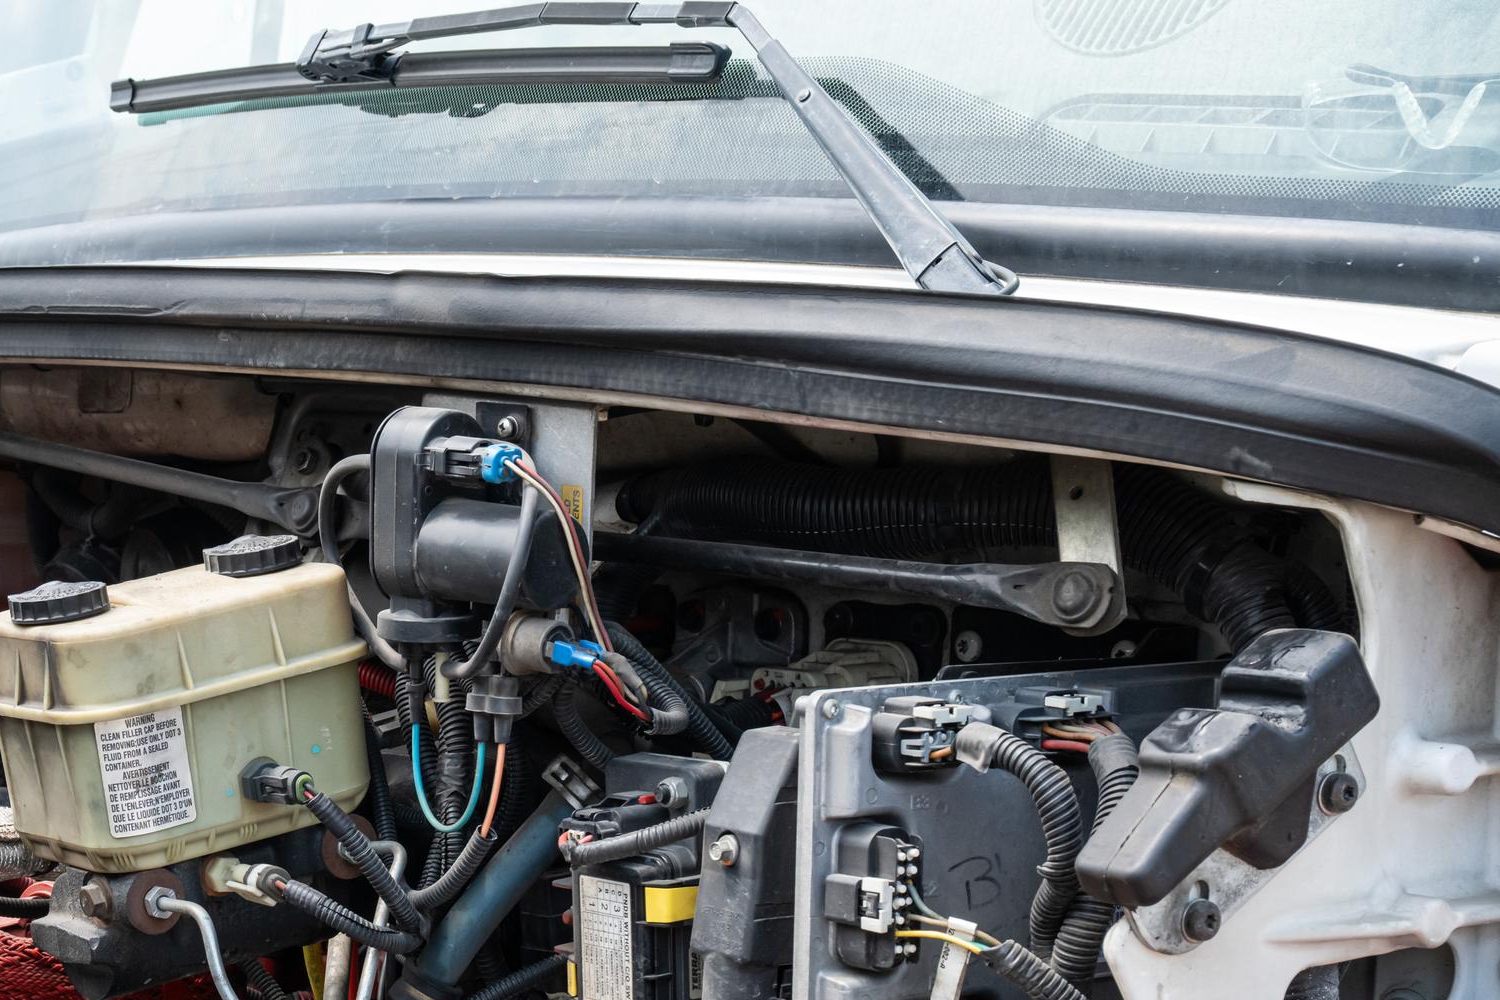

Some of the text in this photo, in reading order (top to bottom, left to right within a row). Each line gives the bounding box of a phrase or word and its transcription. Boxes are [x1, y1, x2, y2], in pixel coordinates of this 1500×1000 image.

[125, 714, 155, 727] WARNING
[100, 719, 177, 741] CLEAN FILLER CAP BEFORE
[149, 733, 164, 743] ONLY
[165, 730, 176, 738] DOT
[104, 753, 121, 761] FLUID
[123, 749, 141, 759] FROM
[148, 742, 168, 752] SEALED
[122, 763, 170, 778] AVERTISSEMENT
[108, 779, 141, 792] NETTOYER
[142, 778, 149, 786] LE
[110, 781, 181, 802] DE REMPLISSAGE AVANT
[111, 804, 120, 813] DE
[113, 814, 125, 823] QUE
[127, 812, 135, 820] LE
[137, 807, 160, 818] LIQUIDE
[162, 804, 172, 813] DOT
[179, 798, 192, 808] D'UN
[115, 819, 151, 833] CONTENANT
